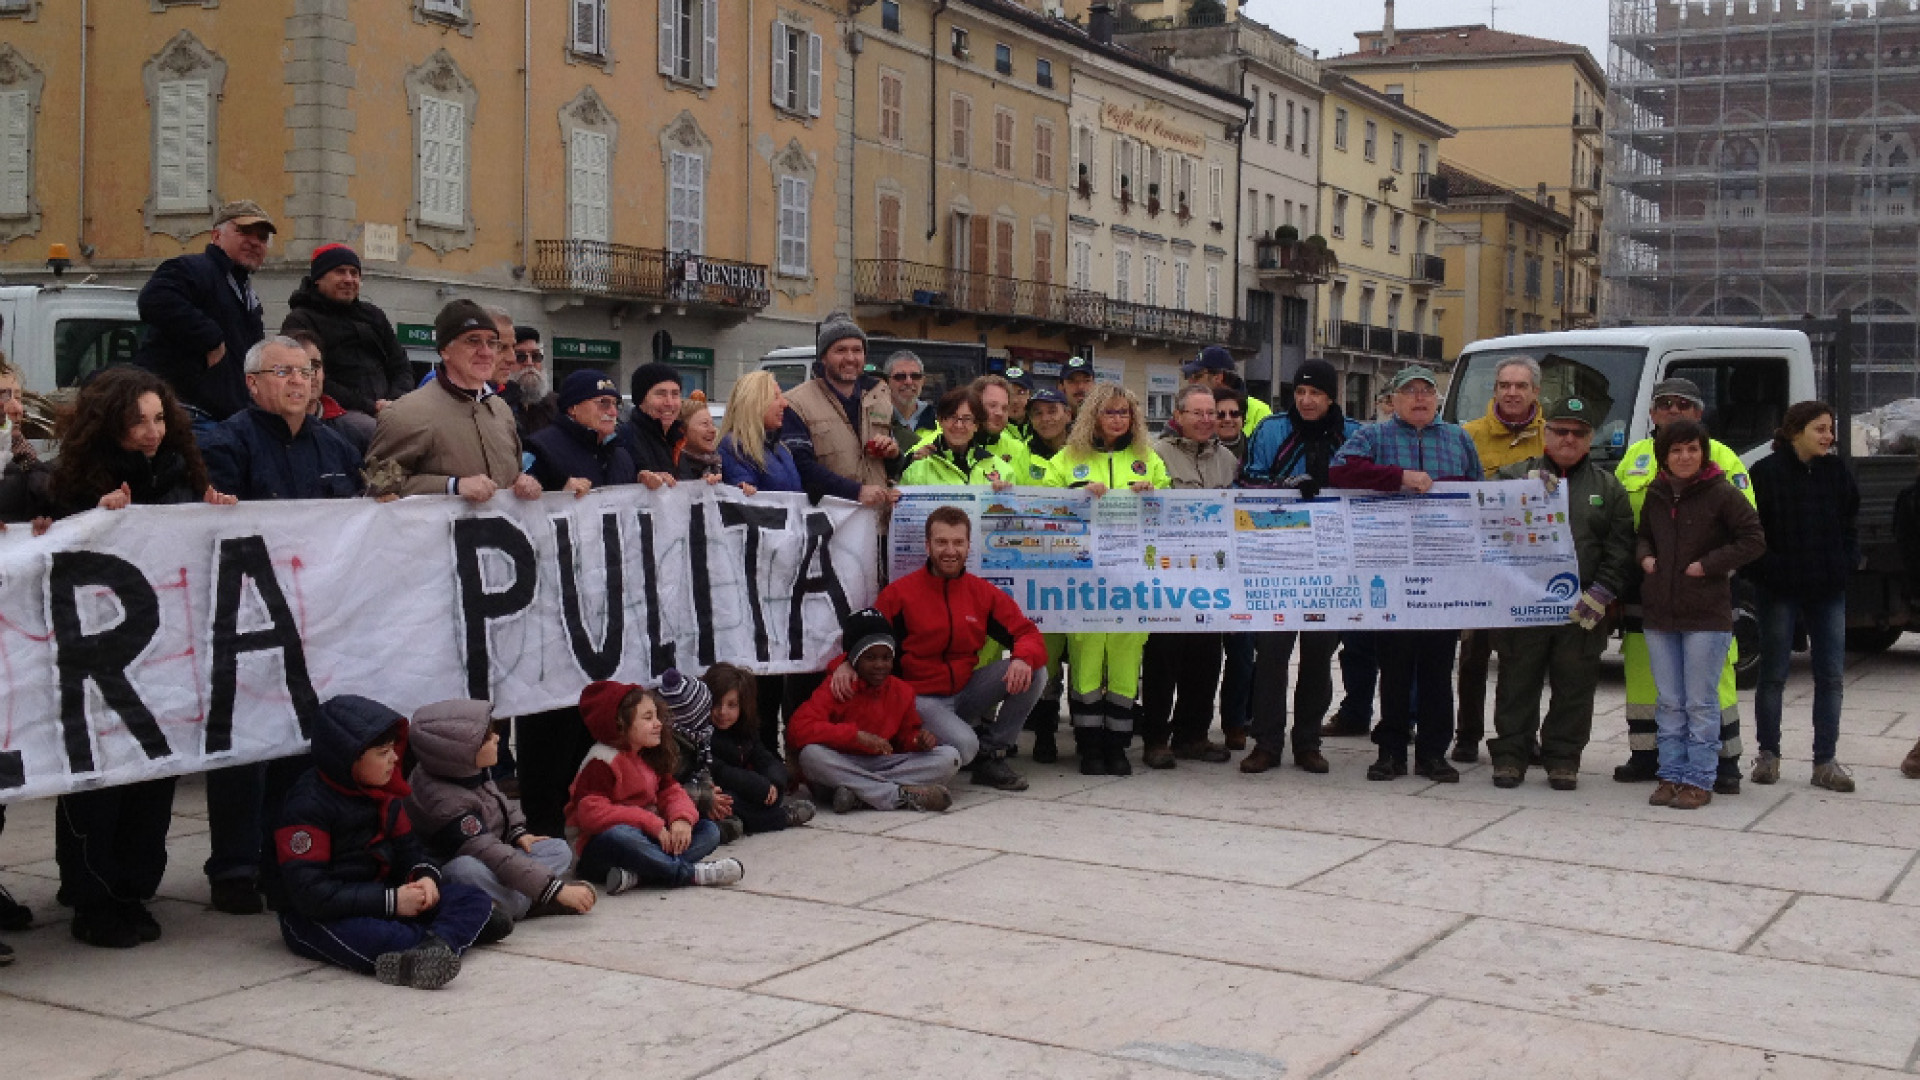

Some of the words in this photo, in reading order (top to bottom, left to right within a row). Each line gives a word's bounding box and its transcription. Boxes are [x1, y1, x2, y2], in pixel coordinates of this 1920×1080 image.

[1244, 575, 1333, 588] RIDUCIAMO
[1027, 577, 1232, 610] Initiatives
[1245, 588, 1297, 599] NOSTRO
[1303, 587, 1361, 597] UTILIZZO
[1246, 600, 1287, 610] DELLA
[1293, 598, 1362, 609] PLASTICA!
[1510, 605, 1572, 616] SURFRIDE
[0, 535, 319, 788] RA
[454, 500, 852, 700] PULITA
